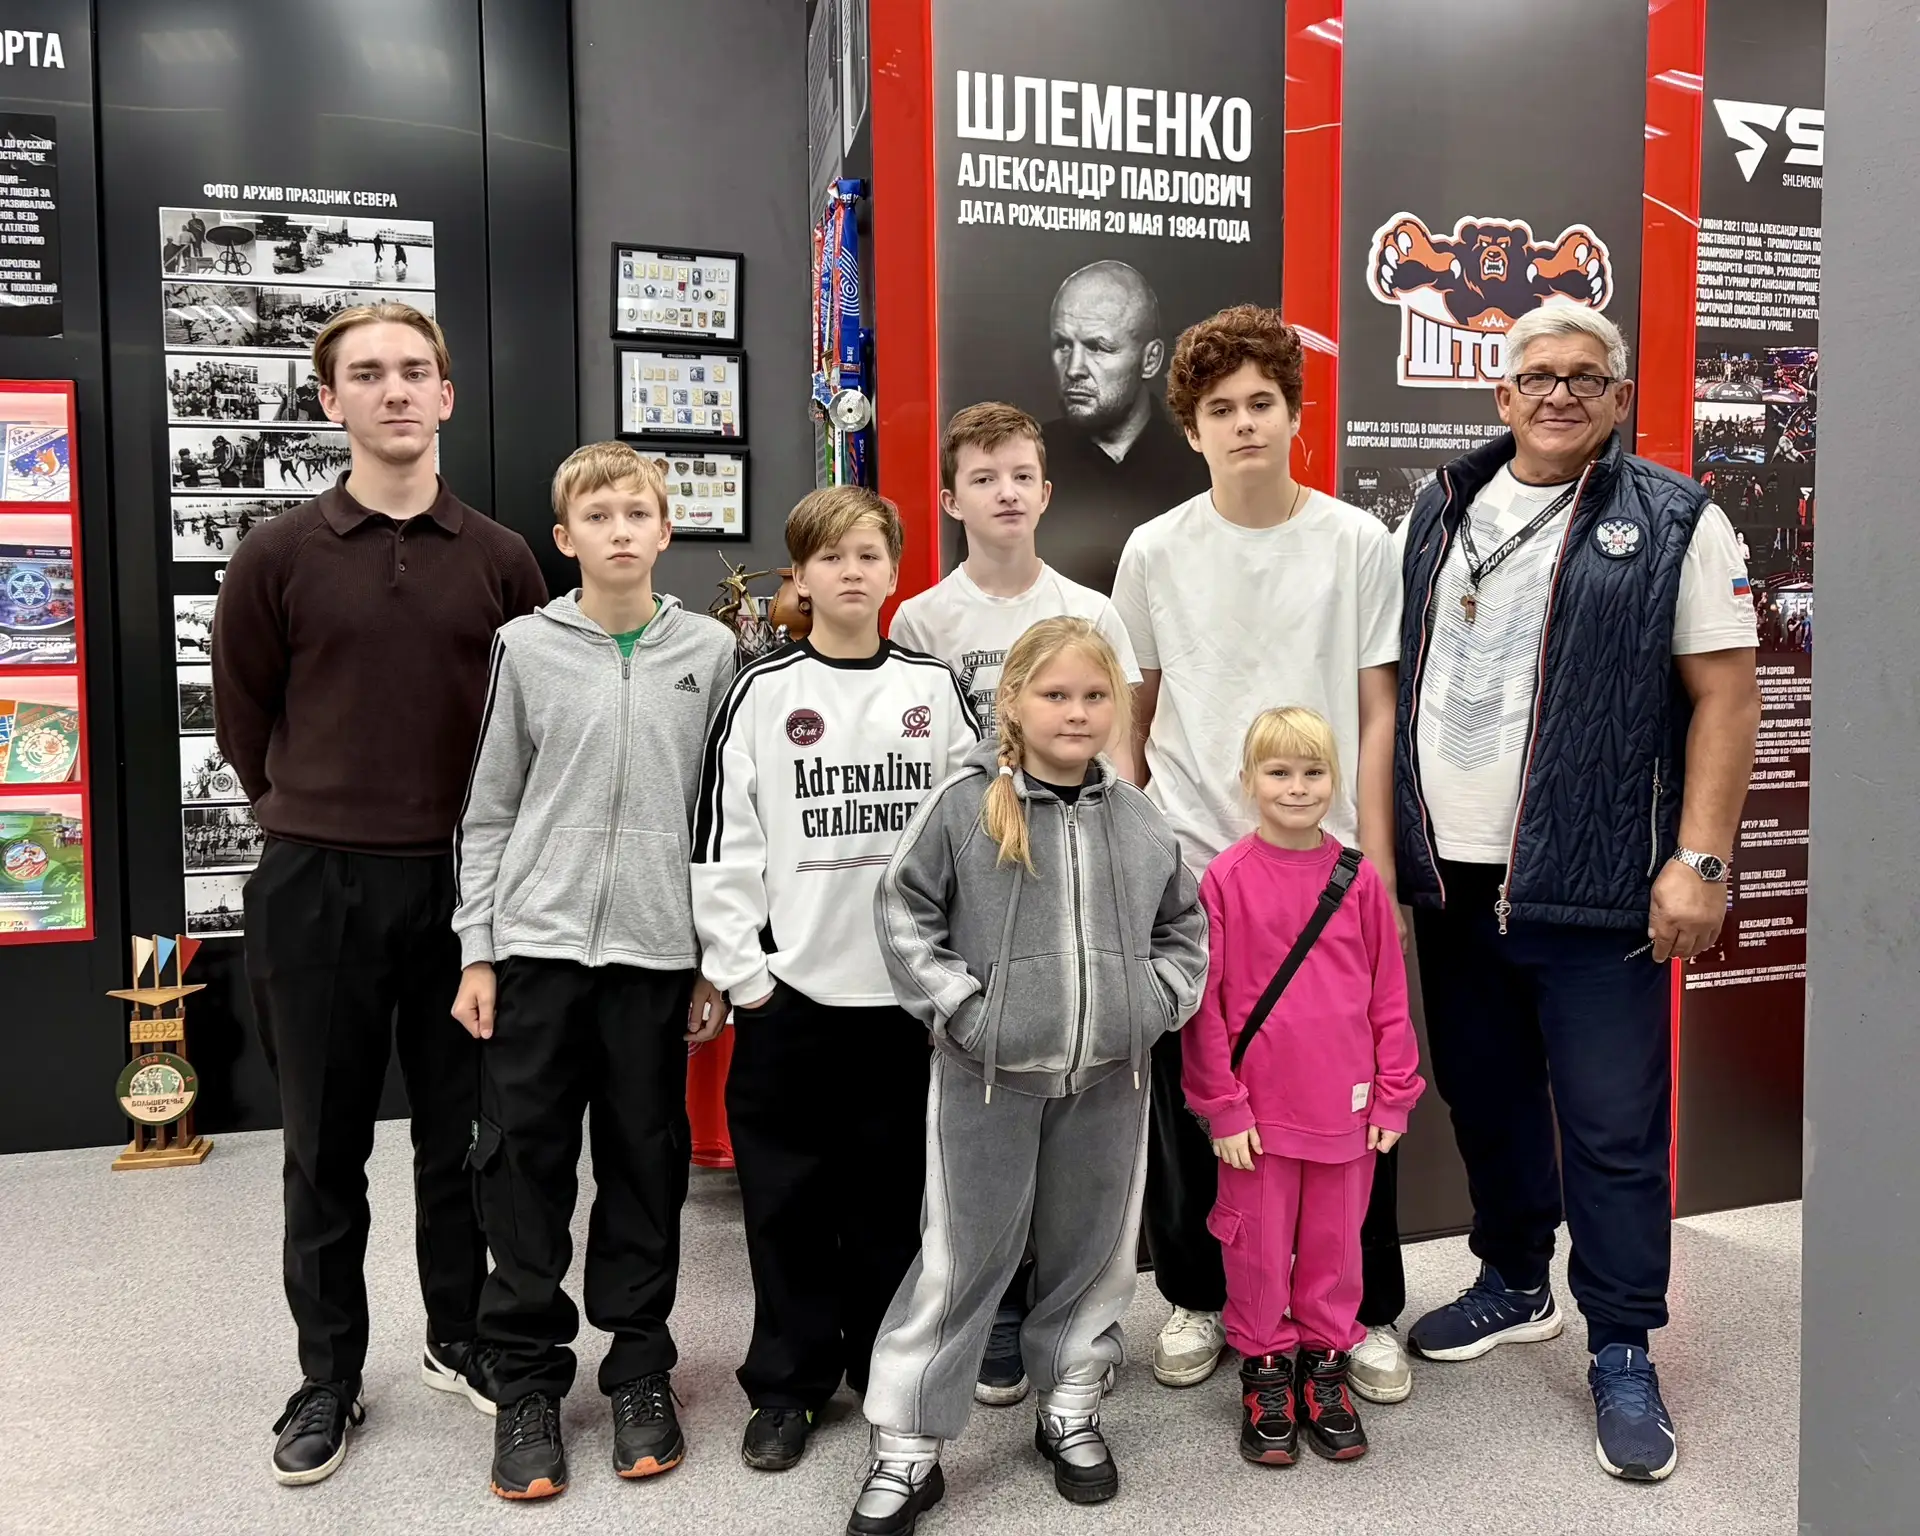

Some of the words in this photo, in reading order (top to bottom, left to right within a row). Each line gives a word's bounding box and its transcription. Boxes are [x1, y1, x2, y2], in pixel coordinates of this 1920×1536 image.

[0, 29, 65, 69] РТА
[956, 69, 1253, 163] ШЛЕМЕНКО
[17, 140, 52, 150] РУССКОЙ
[957, 152, 1116, 201] АЛЕКСАНДР
[1121, 165, 1252, 209] ПАВЛОВИЧ
[10, 187, 39, 197] ЛЮДЕЙ
[40, 189, 51, 197] ЗА
[203, 183, 238, 199] ФОТО
[243, 185, 284, 201] АРХИВ
[285, 187, 351, 205] ПРАЗДНИК
[353, 192, 398, 208] СЕВЕРА
[17, 212, 39, 221] ВЕДЬ
[958, 199, 1005, 226] ДАТА
[1008, 202, 1101, 232] РОЖДЕНИЯ
[1104, 210, 1125, 234] 20
[1129, 211, 1163, 237] МАЯ
[1168, 215, 1206, 240] 1984
[1209, 217, 1251, 244] ГОДА
[5, 223, 39, 233] АТЛЕТОВ
[1703, 219, 1722, 230] ИЮНЯ
[1724, 220, 1740, 232] 2021
[1741, 222, 1758, 234] ГОДА
[1760, 223, 1798, 237] АЛЕКСАНДР
[1799, 227, 1821, 238] ШЛЕМ
[8, 235, 45, 245] ИСТОРИЮ
[1697, 232, 1745, 246] СОБСТВЕННОГО
[1767, 238, 1812, 251] ПРОМОУШЕНА
[1697, 246, 1744, 260] CHAMPIONSHIP
[1764, 252, 1773, 262] ОБ
[1774, 252, 1791, 264] ЭТОМ
[1697, 260, 1742, 273] ЕДИНОБОРСТВ
[11, 282, 57, 293] ПОКОЛЕНИЙ
[1697, 274, 1723, 286] ПЕРВЫЙ
[1724, 276, 1749, 288] ТУРНИР
[1750, 278, 1795, 291] ОРГАНИЗАЦИИ
[1696, 288, 1713, 299] ГОДА
[1715, 289, 1734, 300] БЫЛО
[1735, 291, 1772, 303] ПРОВЕДЕНО
[1774, 293, 1782, 304] 17
[1783, 293, 1817, 306] ТУРНИРОВ.
[1696, 301, 1733, 314] КАРТОЧКОЙ
[1734, 304, 1760, 316] ОМСКОЙ
[1761, 306, 1790, 317] ОБЛАСТИ
[1791, 308, 1796, 318] И
[1696, 316, 1719, 327] САМОМ
[1720, 317, 1766, 330] ВЫСОЧАЙШЕМ
[1767, 320, 1794, 332] УРОВНЕ.
[1407, 311, 1507, 379] ШТО
[1347, 420, 1352, 432] 6
[1353, 421, 1379, 433] МАРТА
[1380, 422, 1399, 434] 2015
[1400, 423, 1420, 435] ГОДА
[1422, 423, 1426, 434] В
[1428, 423, 1452, 435] ОМСКЕ
[1453, 424, 1464, 435] НА
[1465, 424, 1483, 436] БАЗЕ
[1347, 435, 1389, 448] АВТОРСКАЯ
[1390, 436, 1418, 449] ШКОЛА
[1419, 438, 1470, 450] ЕДИНОБОРСТВ
[901, 729, 931, 738] RUN
[134, 1021, 178, 1041] 1992
[132, 1097, 185, 1107] БОЛЬШЕРЕЧЬЕ
